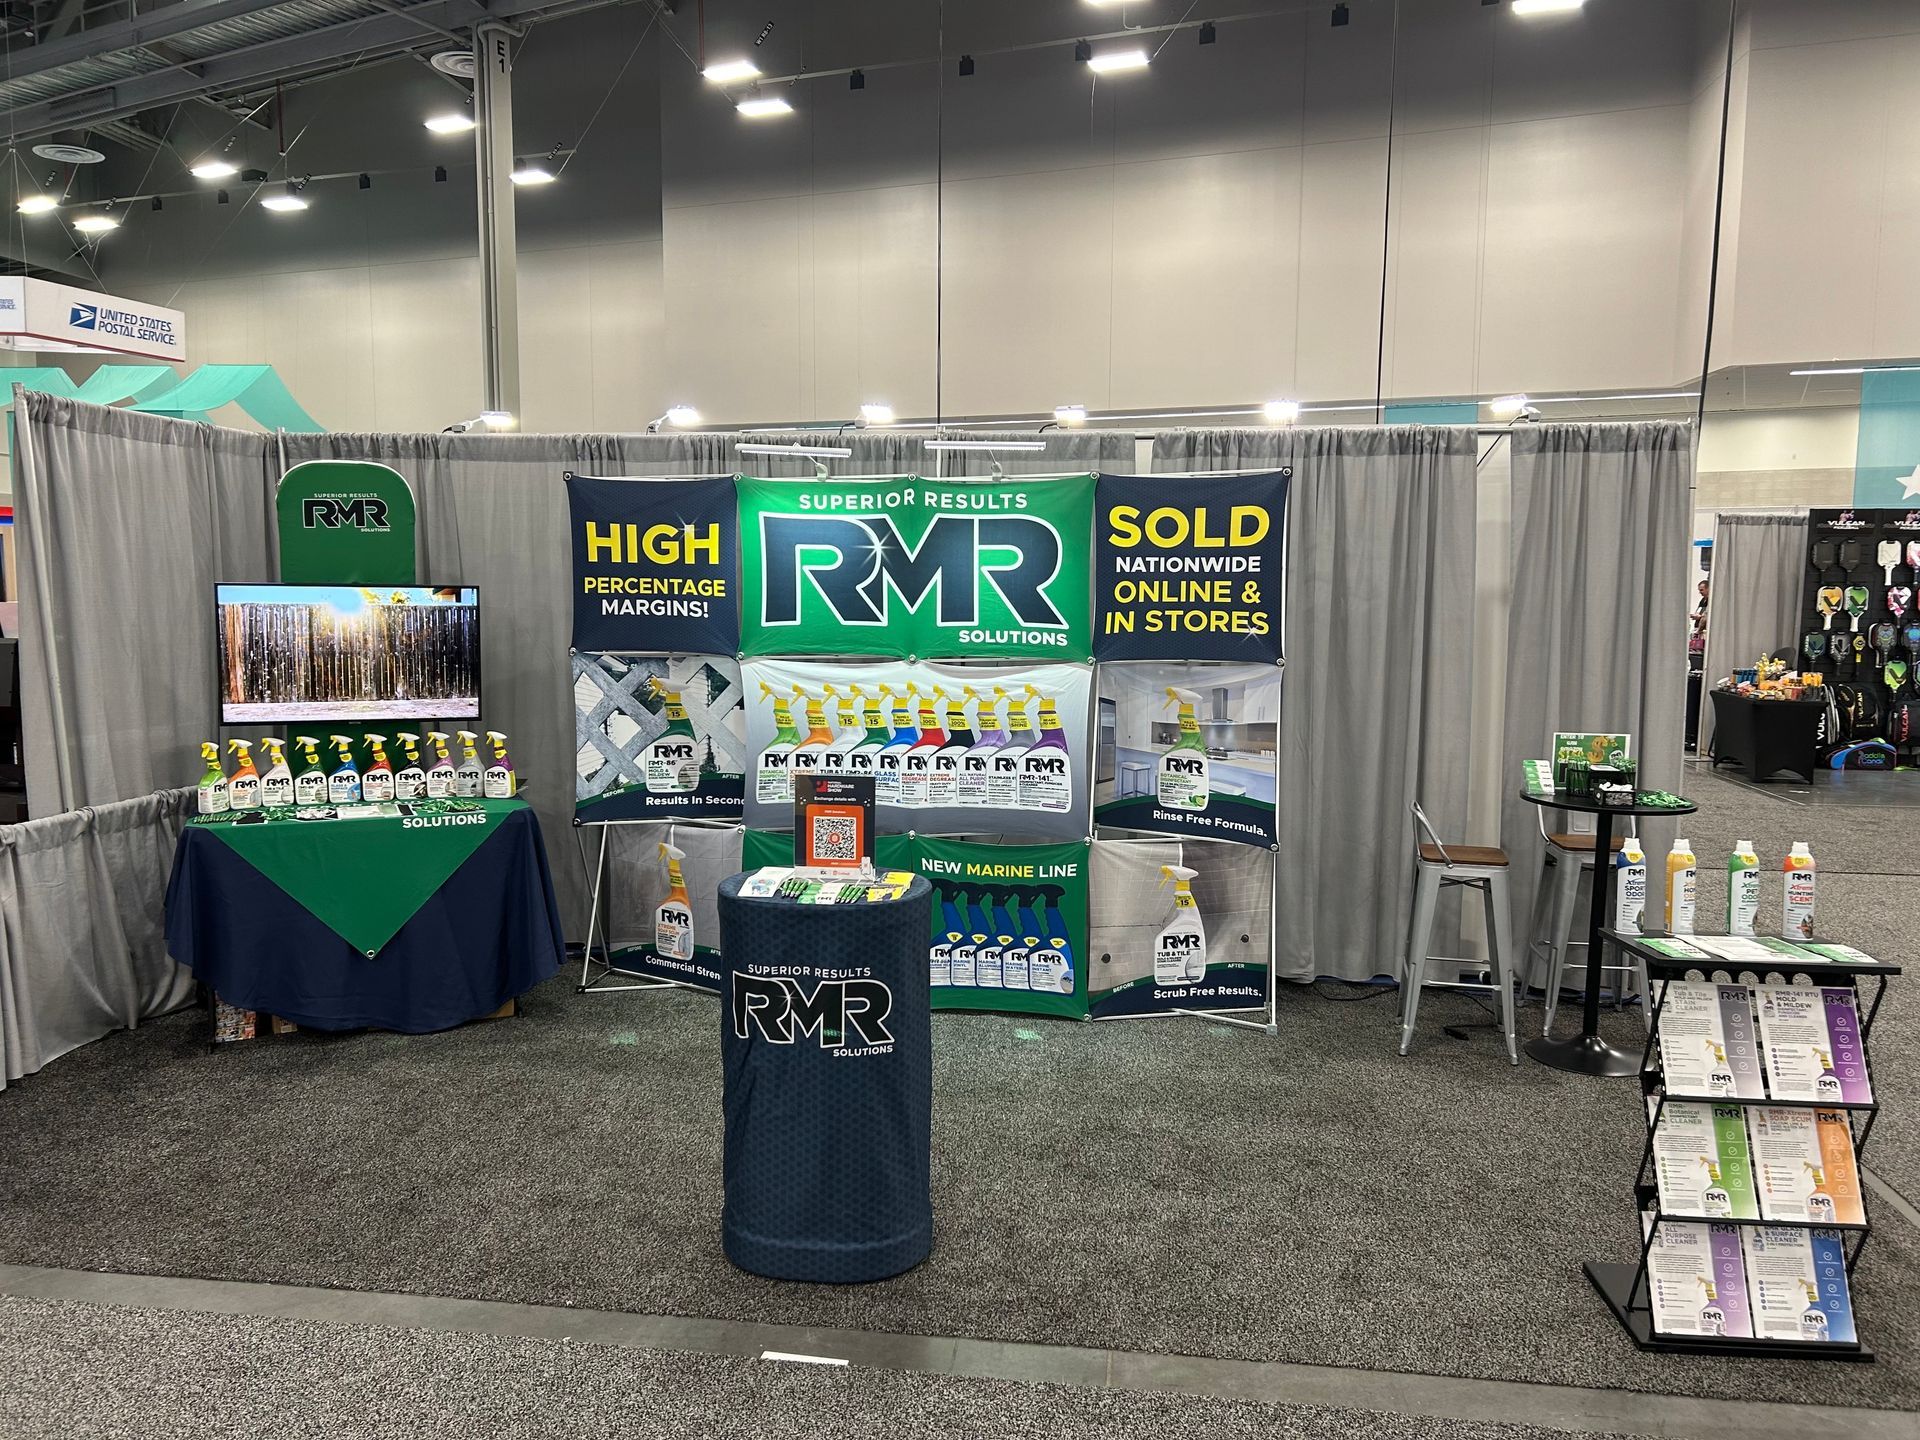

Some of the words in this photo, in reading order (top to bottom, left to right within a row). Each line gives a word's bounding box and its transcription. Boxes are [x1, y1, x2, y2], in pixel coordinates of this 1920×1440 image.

[100, 308, 138, 325] UNITED
[139, 316, 172, 332] STATES
[98, 321, 135, 338] POSTAL
[799, 488, 915, 510] SUPERIOR
[924, 491, 1028, 510] RESULTS
[302, 498, 391, 528] RMR
[1108, 505, 1270, 548] SOLD
[585, 521, 720, 564] HIGH
[758, 511, 1069, 629] RMR
[1115, 556, 1261, 573] NATIONWIDE
[584, 577, 726, 597] PERCENTAGE
[1114, 580, 1232, 603] ONLINE
[1241, 580, 1261, 604] &
[601, 599, 709, 618] MARGINS!
[1105, 611, 1135, 635] IN
[1144, 610, 1270, 635] STORES
[959, 630, 1068, 646] SOLUTIONS
[1900, 704, 1909, 742] VULCAN
[654, 745, 693, 758] RMR
[1025, 758, 1065, 774] RMR
[1166, 758, 1203, 774] RMR
[301, 776, 324, 785] RMR
[334, 775, 356, 784] RMR
[367, 774, 389, 782] RMR
[400, 773, 422, 781] RMR
[432, 771, 453, 779] RMR
[235, 780, 258, 789] RMR
[266, 778, 290, 786] RMR
[602, 788, 625, 798] BEFORE
[646, 796, 689, 806] Results
[691, 796, 703, 804] In
[402, 814, 487, 828] SOLUTIONS
[1153, 810, 1184, 822] Rinse
[1186, 813, 1212, 826] Free
[1215, 818, 1268, 837] Formula.
[921, 857, 961, 874] NEW
[967, 863, 1034, 878] MARINE
[1039, 863, 1078, 878] LINE
[661, 909, 689, 926] RMR
[1163, 935, 1200, 949] RMR
[645, 955, 695, 974] Commercial
[1038, 954, 1061, 964] RMR
[748, 964, 811, 976] SUPERIOR
[814, 967, 871, 978] RESULTS
[1113, 982, 1134, 993] BEFORE
[1154, 987, 1187, 998] Scrub
[1190, 988, 1215, 996] Free
[1218, 987, 1262, 997] Results.
[1720, 991, 1747, 1001] RMR
[1824, 995, 1852, 1004] RMR
[732, 970, 895, 1048] RMR
[833, 1045, 893, 1057] SOLUTIONS
[1711, 1074, 1732, 1082] RMR
[1818, 1080, 1838, 1088] RMR
[1715, 1109, 1740, 1118] RMR
[1817, 1113, 1845, 1122] RMR
[1706, 1193, 1727, 1202] RMR
[1810, 1198, 1831, 1207] RMR
[1710, 1224, 1736, 1234] RMR
[1703, 1312, 1722, 1320] RMR
[1804, 1315, 1824, 1323] RMR
